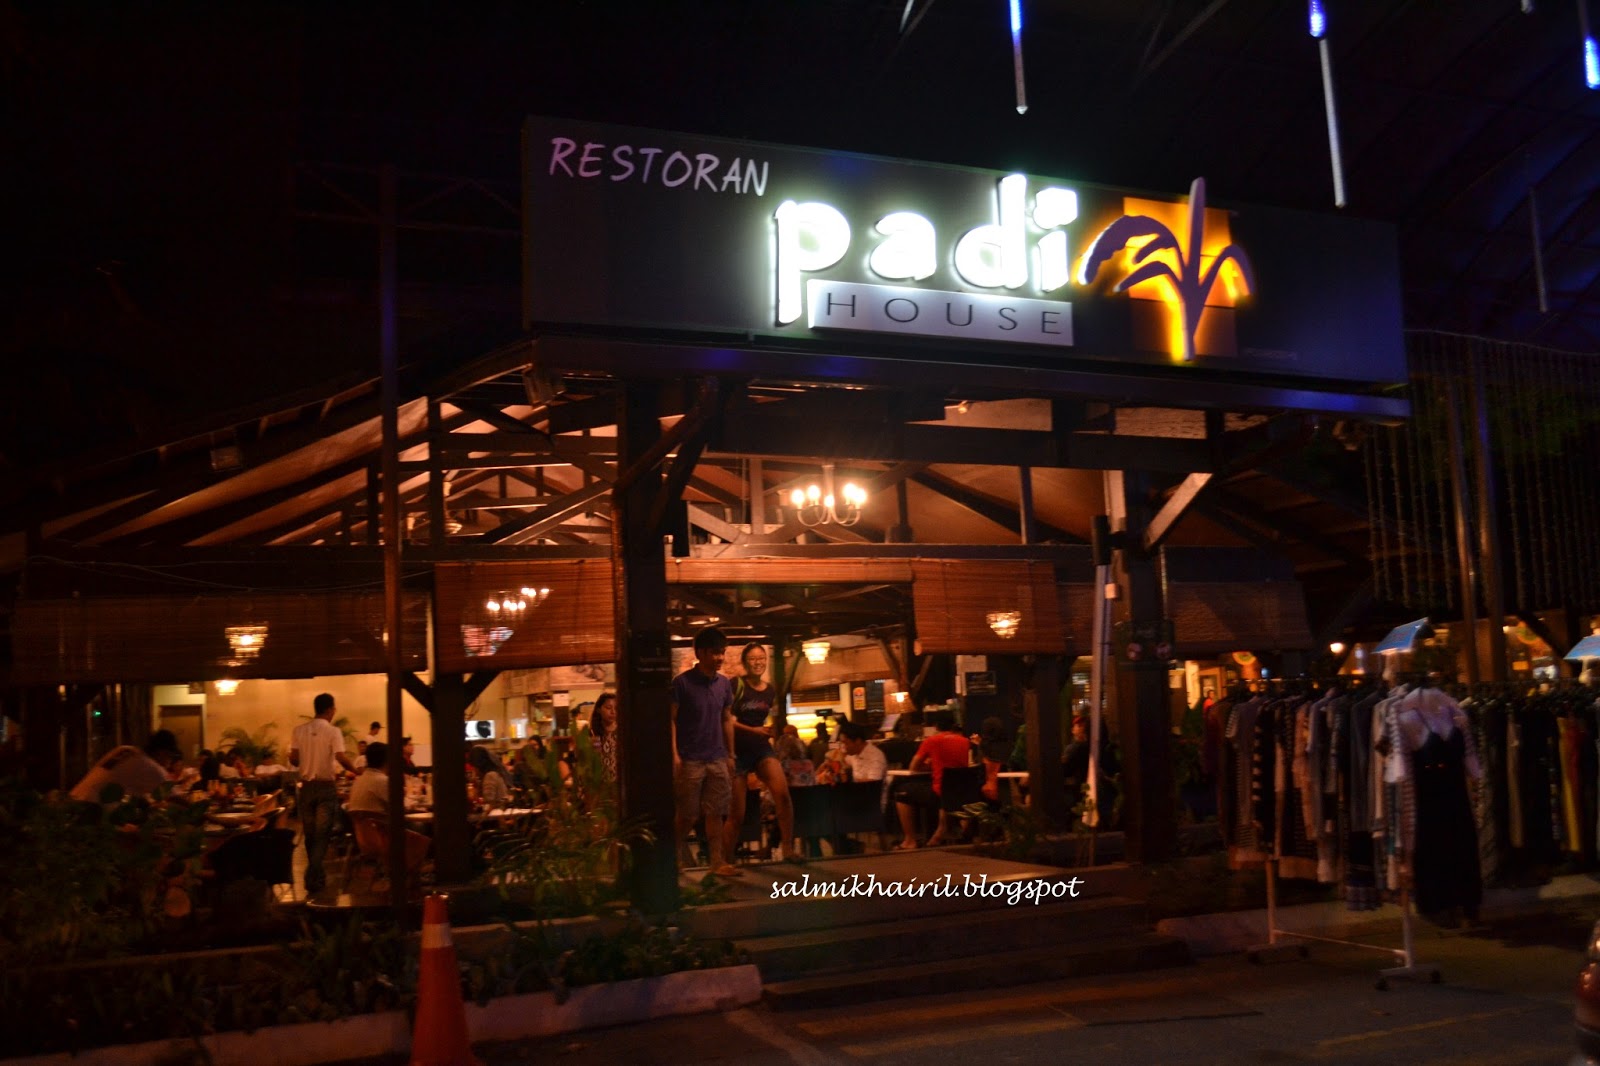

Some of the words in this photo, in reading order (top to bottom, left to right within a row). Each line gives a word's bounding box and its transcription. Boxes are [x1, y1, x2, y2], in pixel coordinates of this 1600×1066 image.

[549, 137, 769, 197] RESTORAN
[772, 173, 1078, 327] padi
[826, 292, 1062, 335] HOUSE
